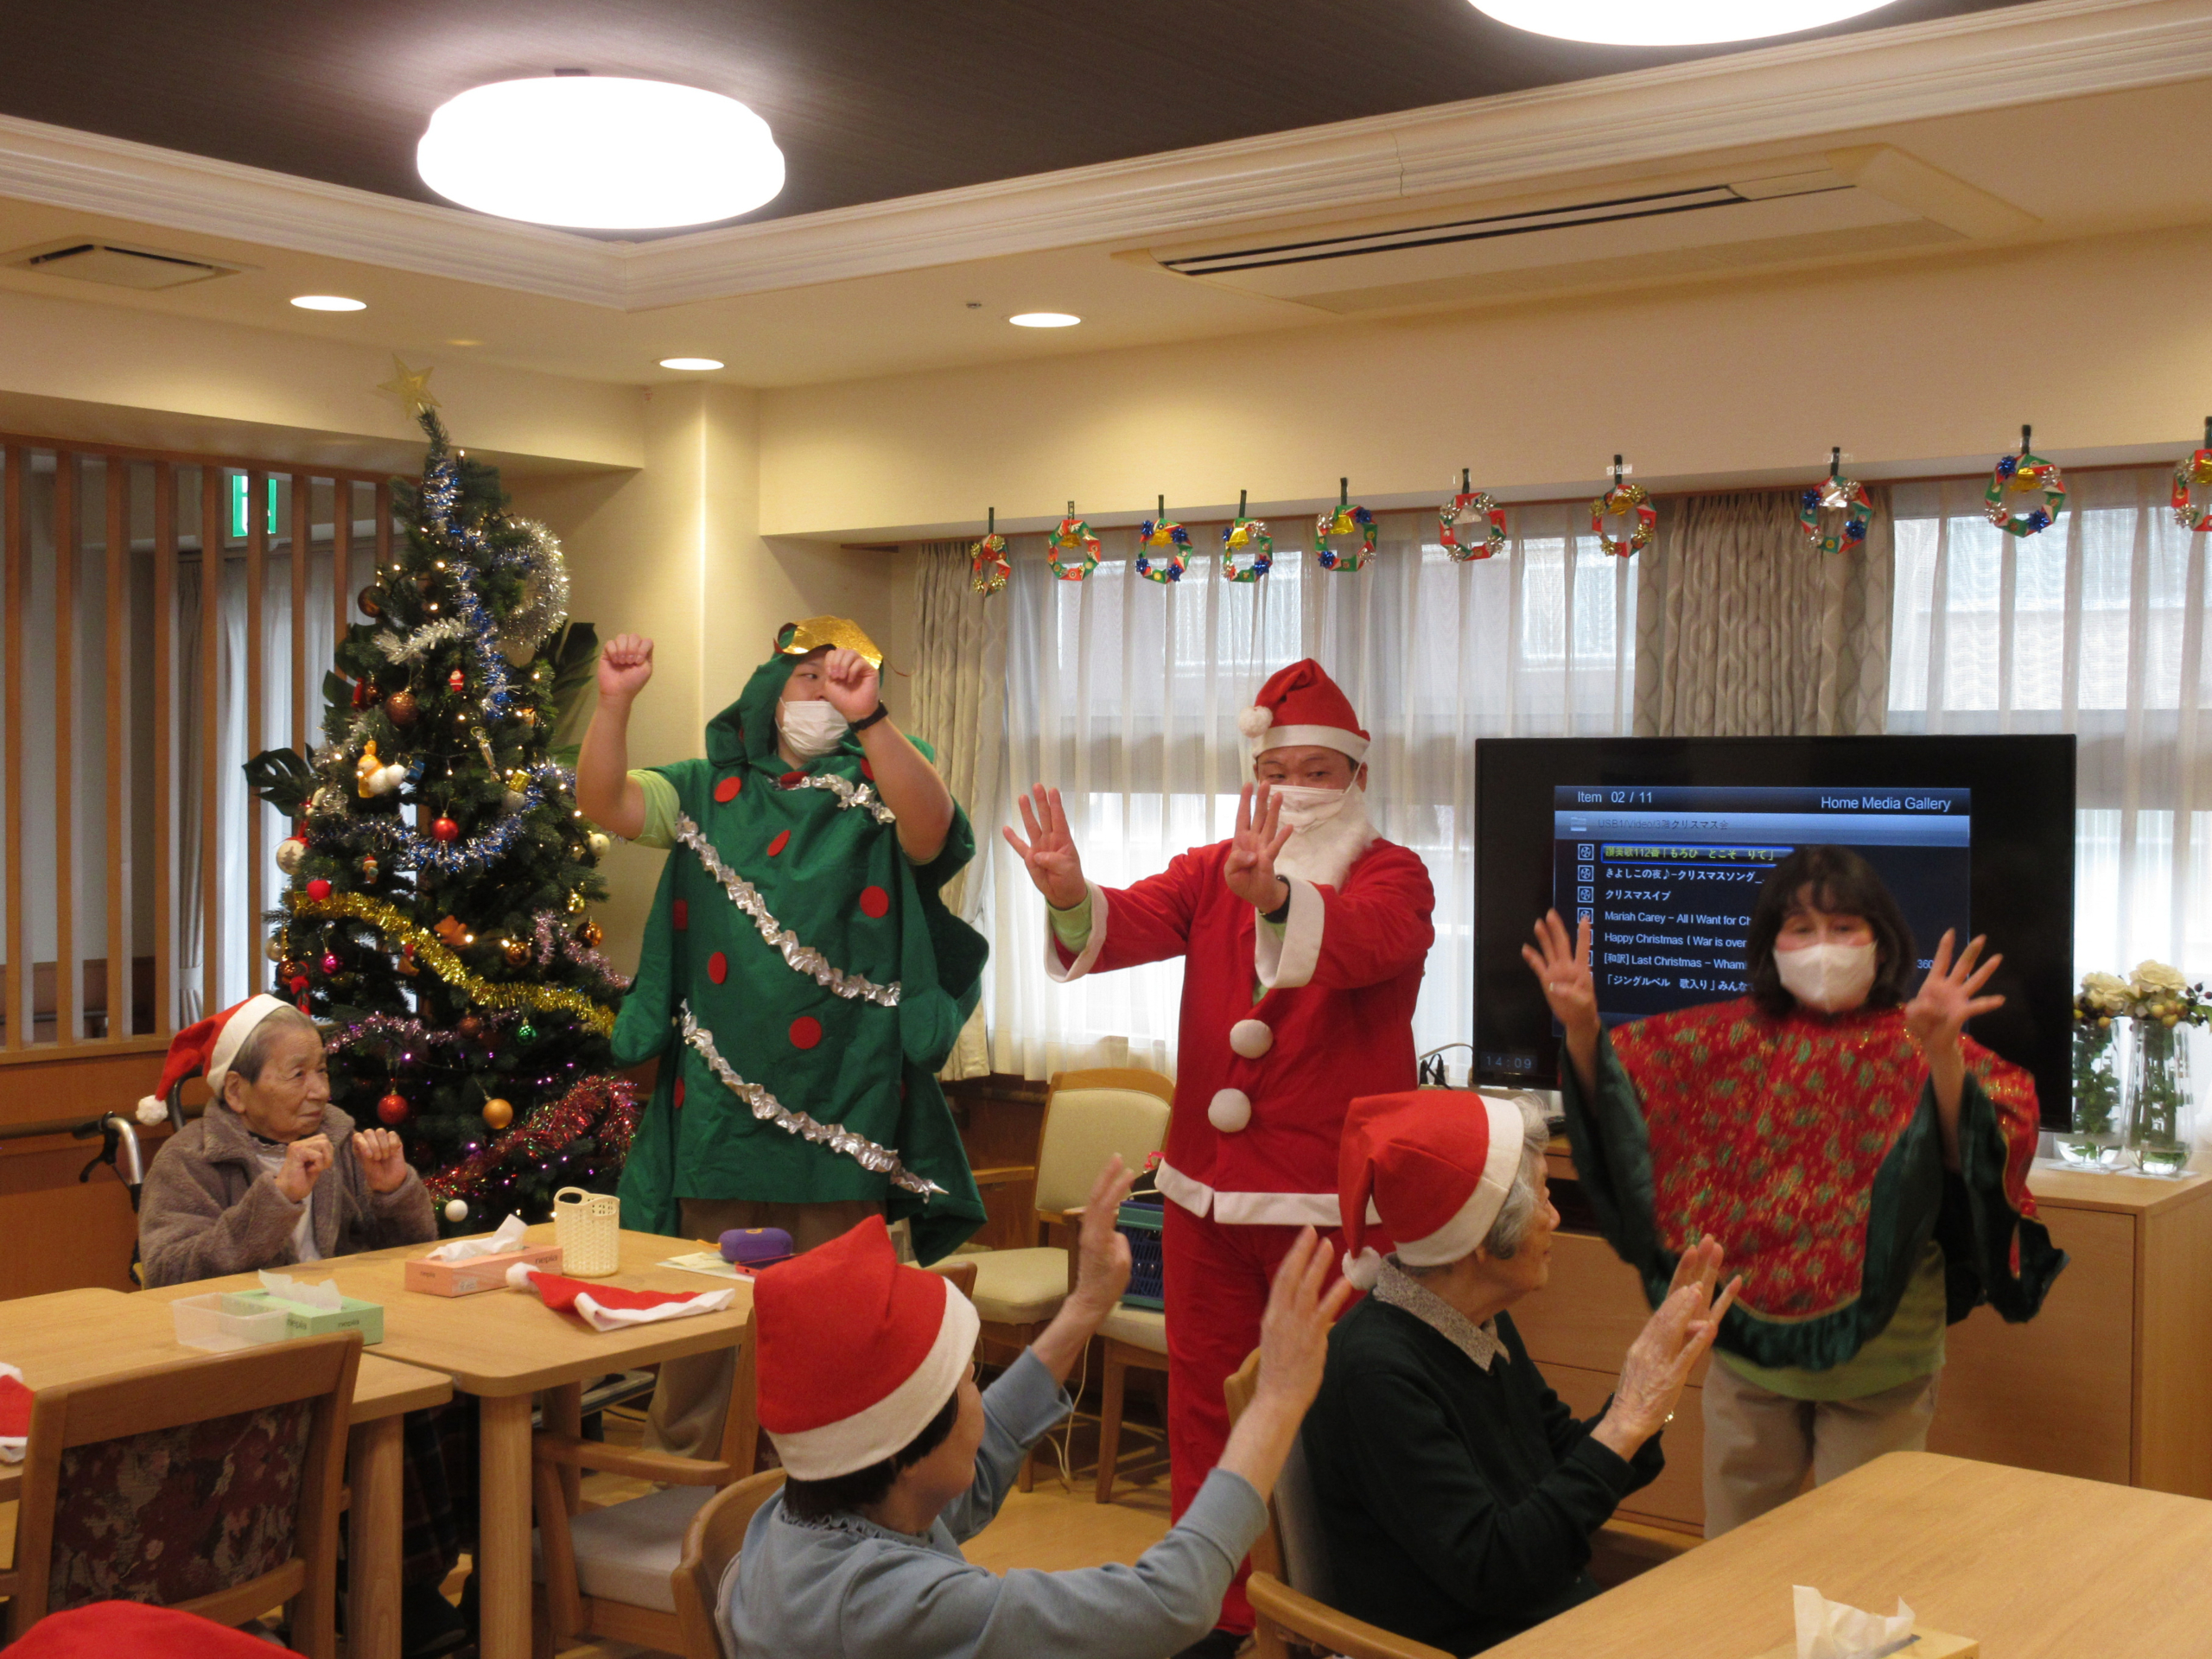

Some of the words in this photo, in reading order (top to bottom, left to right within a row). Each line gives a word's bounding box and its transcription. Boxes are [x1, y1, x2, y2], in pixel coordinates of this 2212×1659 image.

[1578, 791, 1602, 803] Item
[1611, 791, 1625, 803] 02
[1639, 791, 1652, 803] 11
[1821, 797, 1859, 809] Home
[1862, 797, 1901, 809] Media
[1904, 797, 1951, 812] Gallery
[1605, 890, 1671, 900] クリスマスイブ
[1605, 912, 1636, 921] Mariah
[1637, 912, 1666, 924] Carey
[1676, 914, 1688, 924] All
[1690, 914, 1694, 924] I
[1696, 915, 1721, 925] Want
[1723, 915, 1737, 925] for
[1605, 932, 1634, 944] Happy
[1636, 934, 1683, 944] Christmas
[1693, 936, 1713, 946] War
[1714, 937, 1723, 947] is
[1725, 939, 1747, 948] over
[1604, 953, 1630, 965] [和訳]
[1631, 956, 1652, 965] Last
[1654, 957, 1702, 967] Christmas
[1607, 974, 1670, 987] 「ジングルベル
[1486, 1056, 1532, 1070] 14:09
[535, 1254, 558, 1265] nepia
